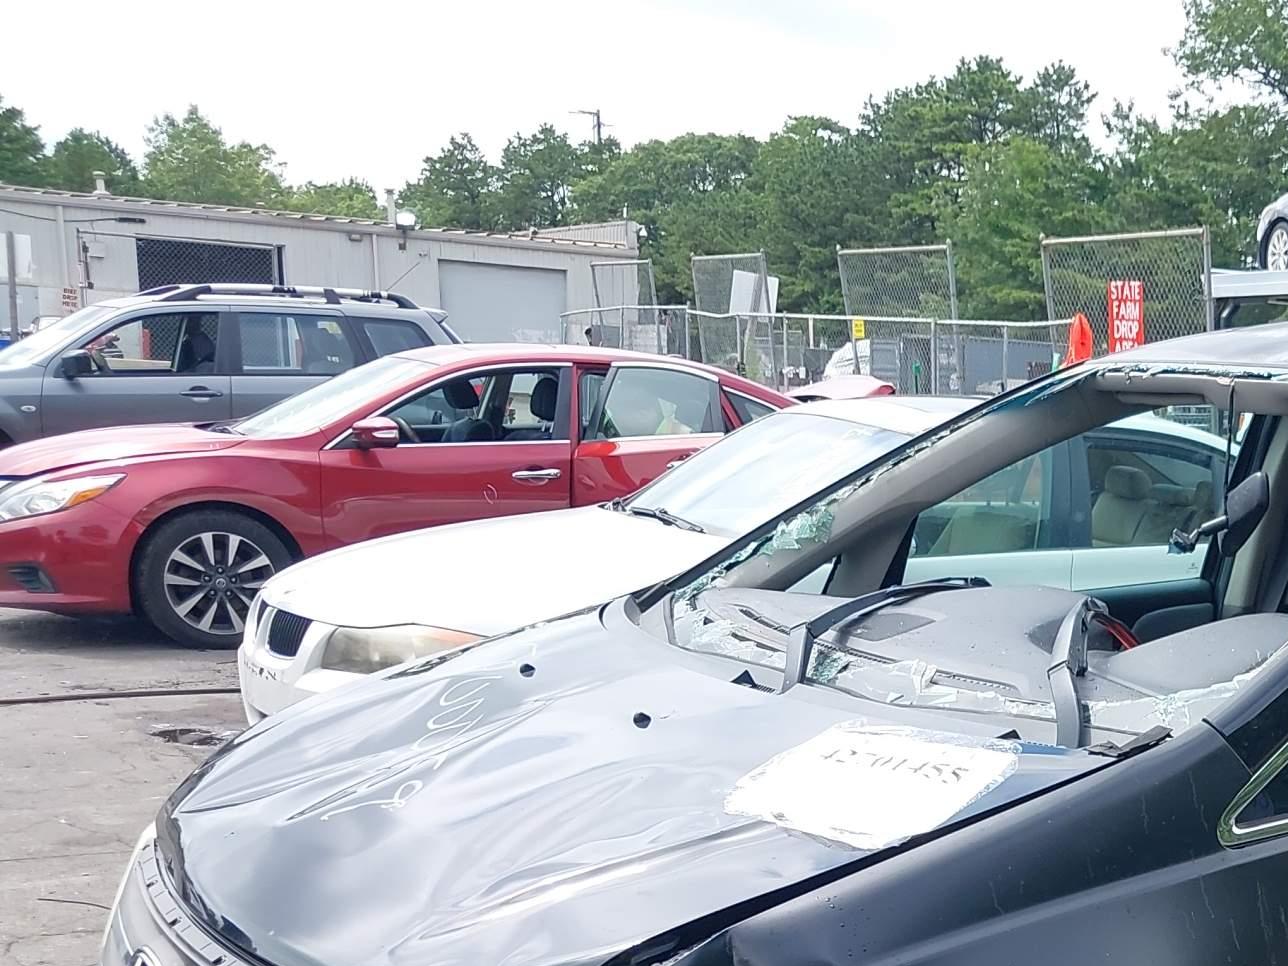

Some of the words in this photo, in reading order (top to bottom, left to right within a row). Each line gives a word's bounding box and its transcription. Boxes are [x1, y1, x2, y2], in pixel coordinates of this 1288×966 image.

[1110, 280, 1141, 300] STATE
[1112, 300, 1140, 320] FARM
[1113, 320, 1140, 339] DROP
